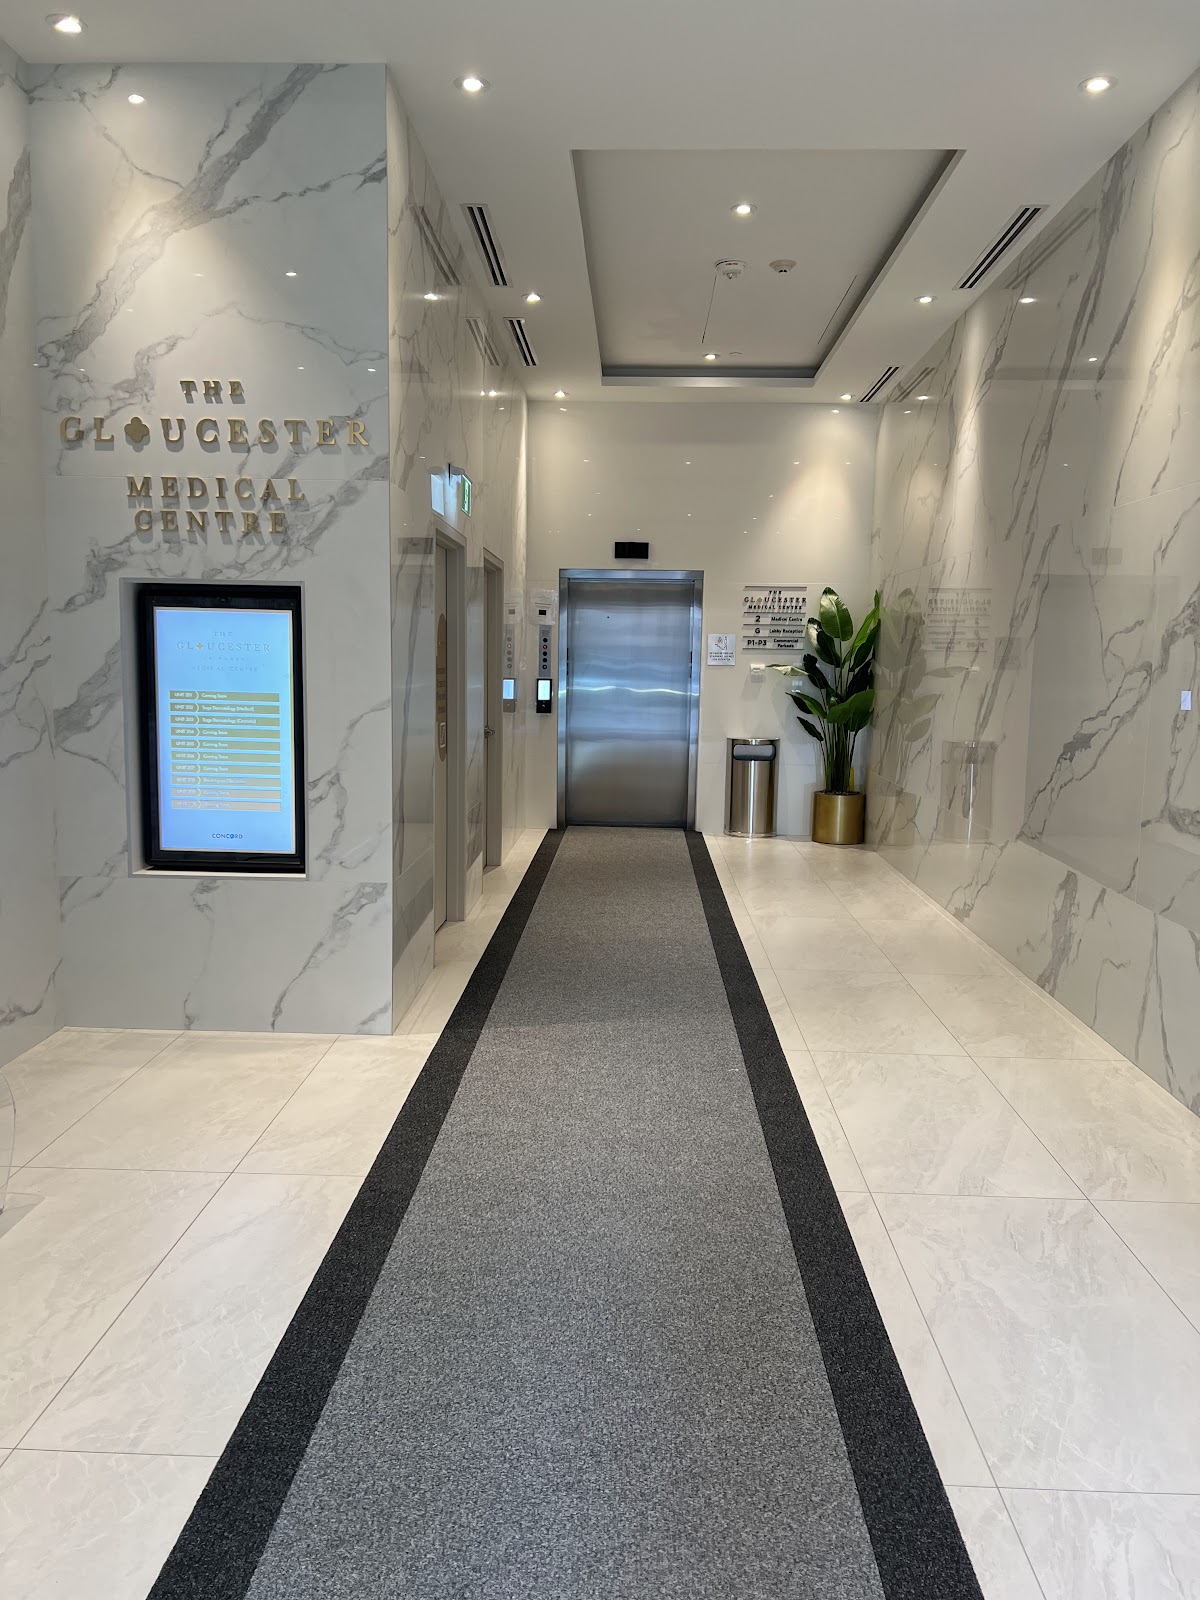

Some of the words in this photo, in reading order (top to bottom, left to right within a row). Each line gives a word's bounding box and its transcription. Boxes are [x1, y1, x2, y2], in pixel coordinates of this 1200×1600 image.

[180, 380, 242, 396] THE
[126, 476, 306, 501] MEDICAL
[134, 510, 287, 534] CENTRE
